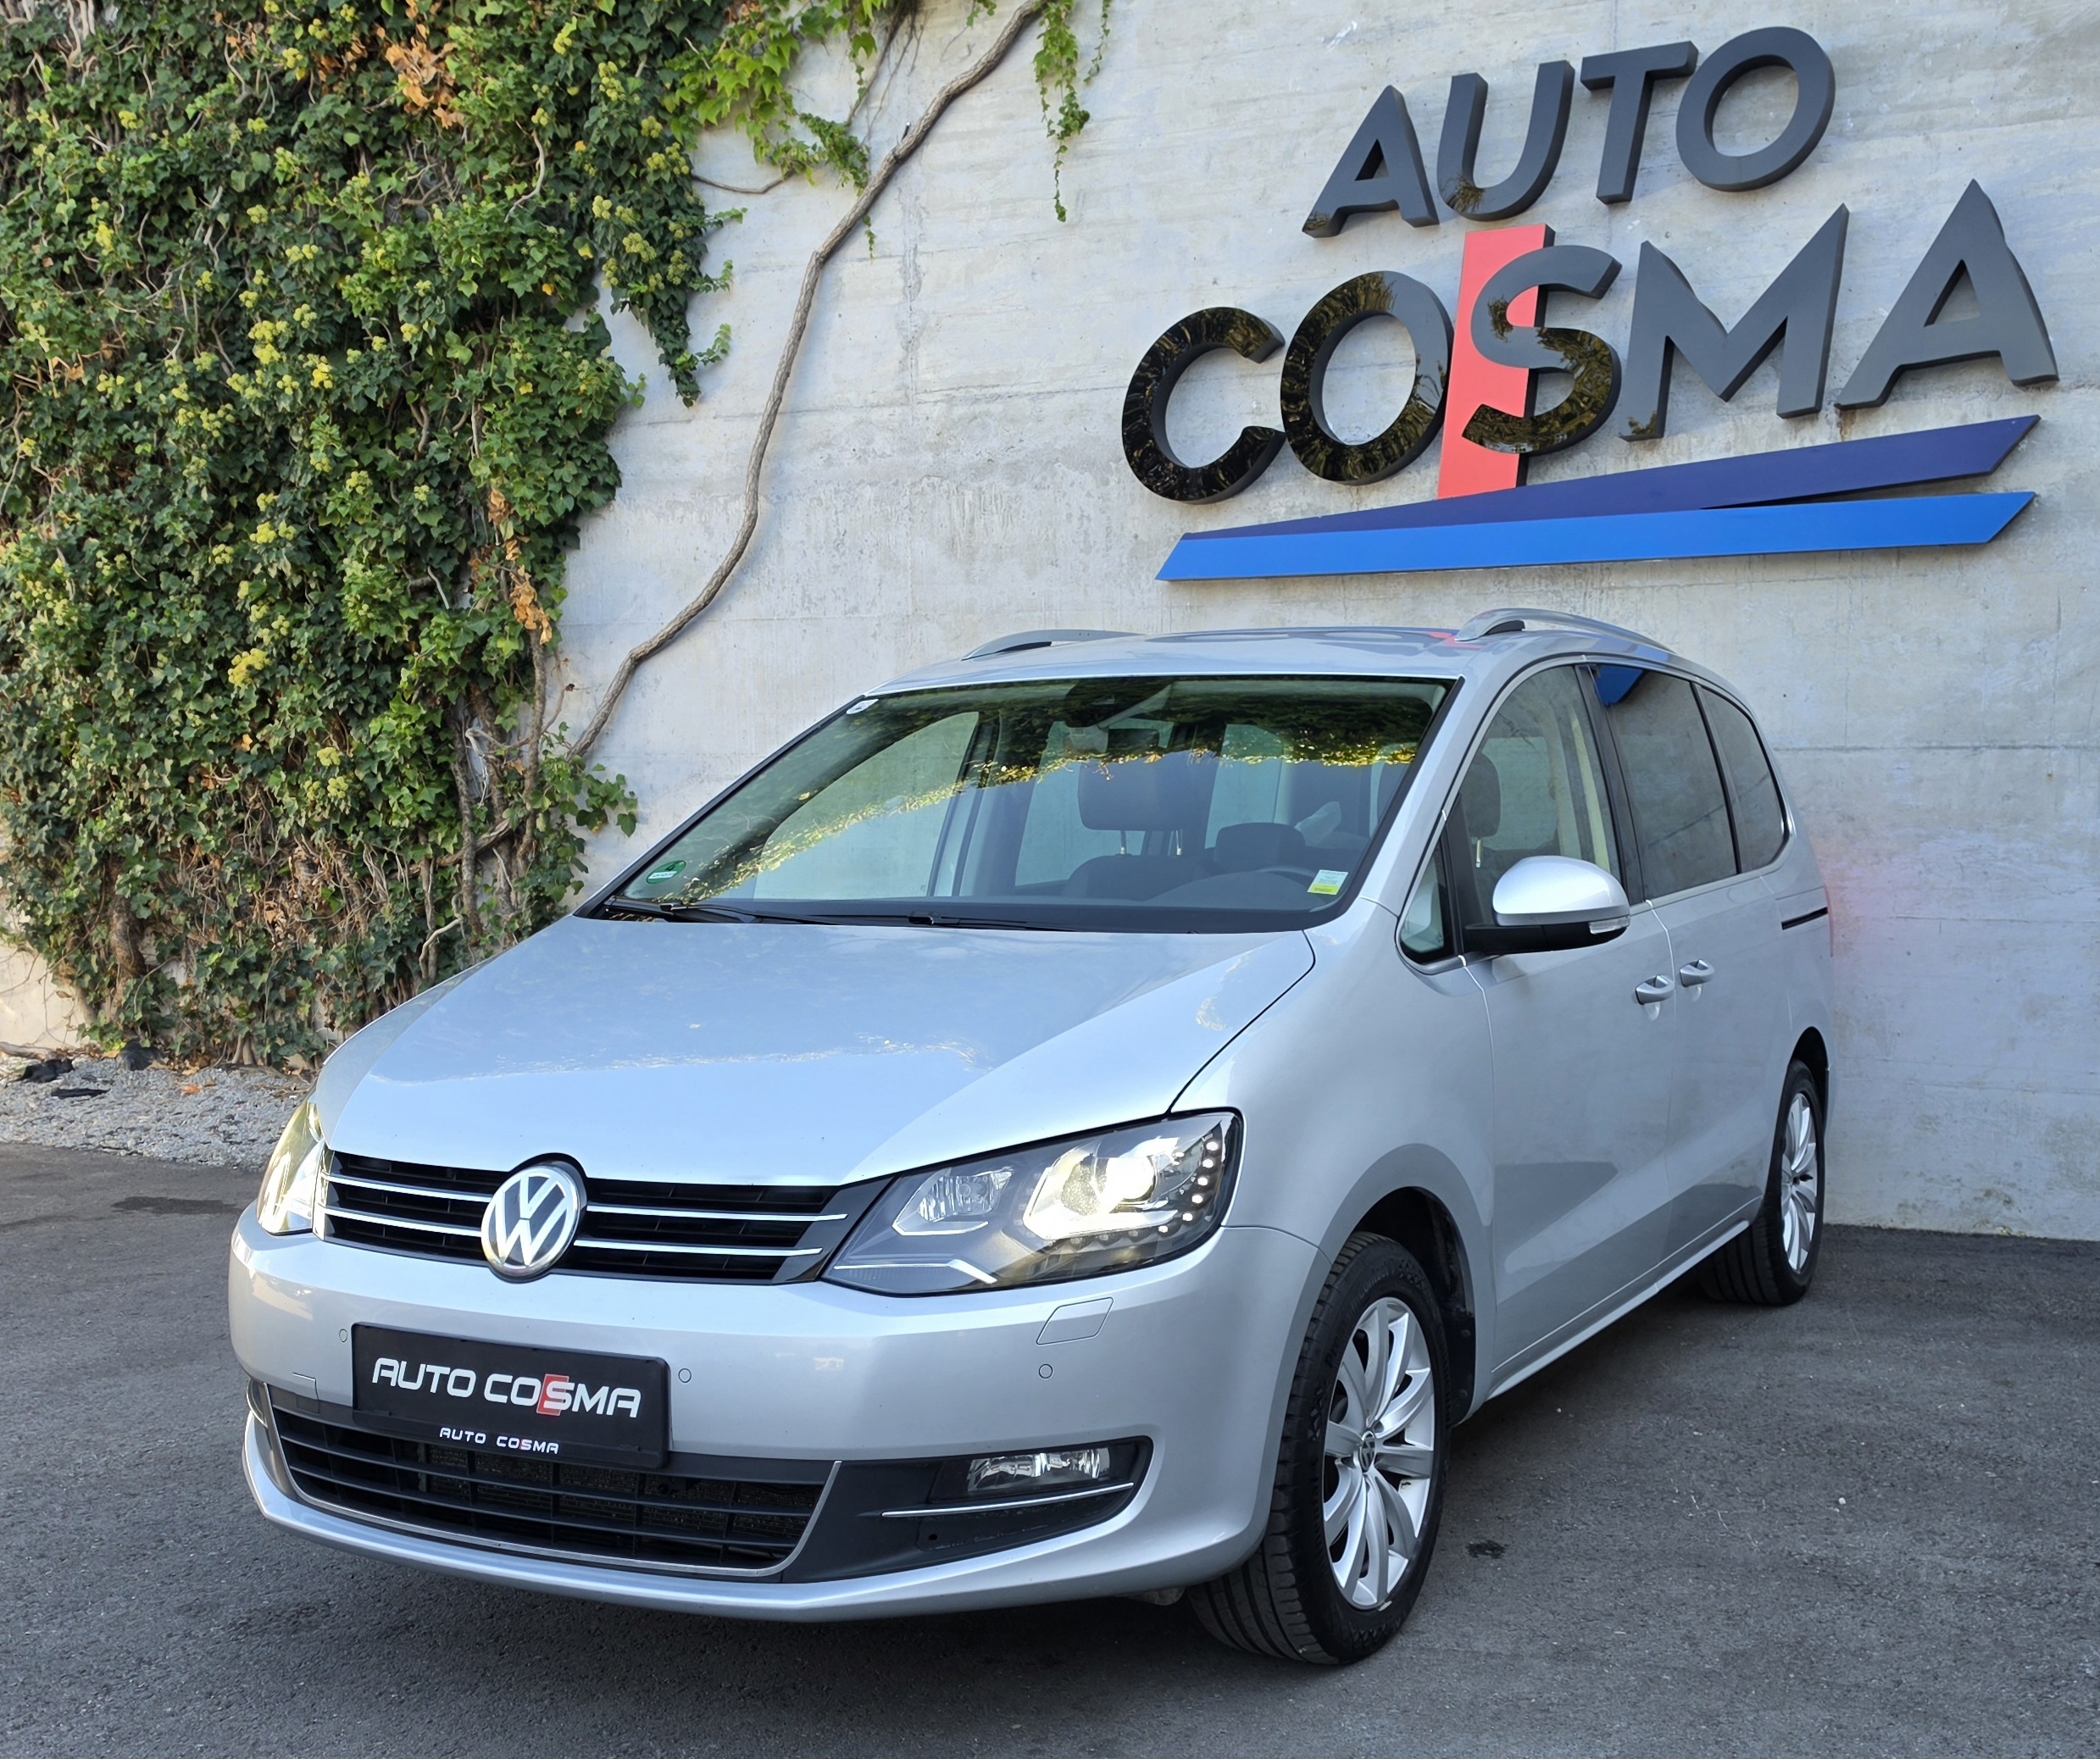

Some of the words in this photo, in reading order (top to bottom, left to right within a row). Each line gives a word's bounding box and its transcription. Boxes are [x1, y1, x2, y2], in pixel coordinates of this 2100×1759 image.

[1302, 25, 1836, 239] AUTO
[1122, 179, 2059, 504] COSMA
[489, 1169, 573, 1270] VW
[372, 1357, 476, 1398] AUTO
[484, 1374, 642, 1418] COSMA
[439, 1427, 486, 1445] AUTO
[496, 1436, 560, 1455] COSMA
